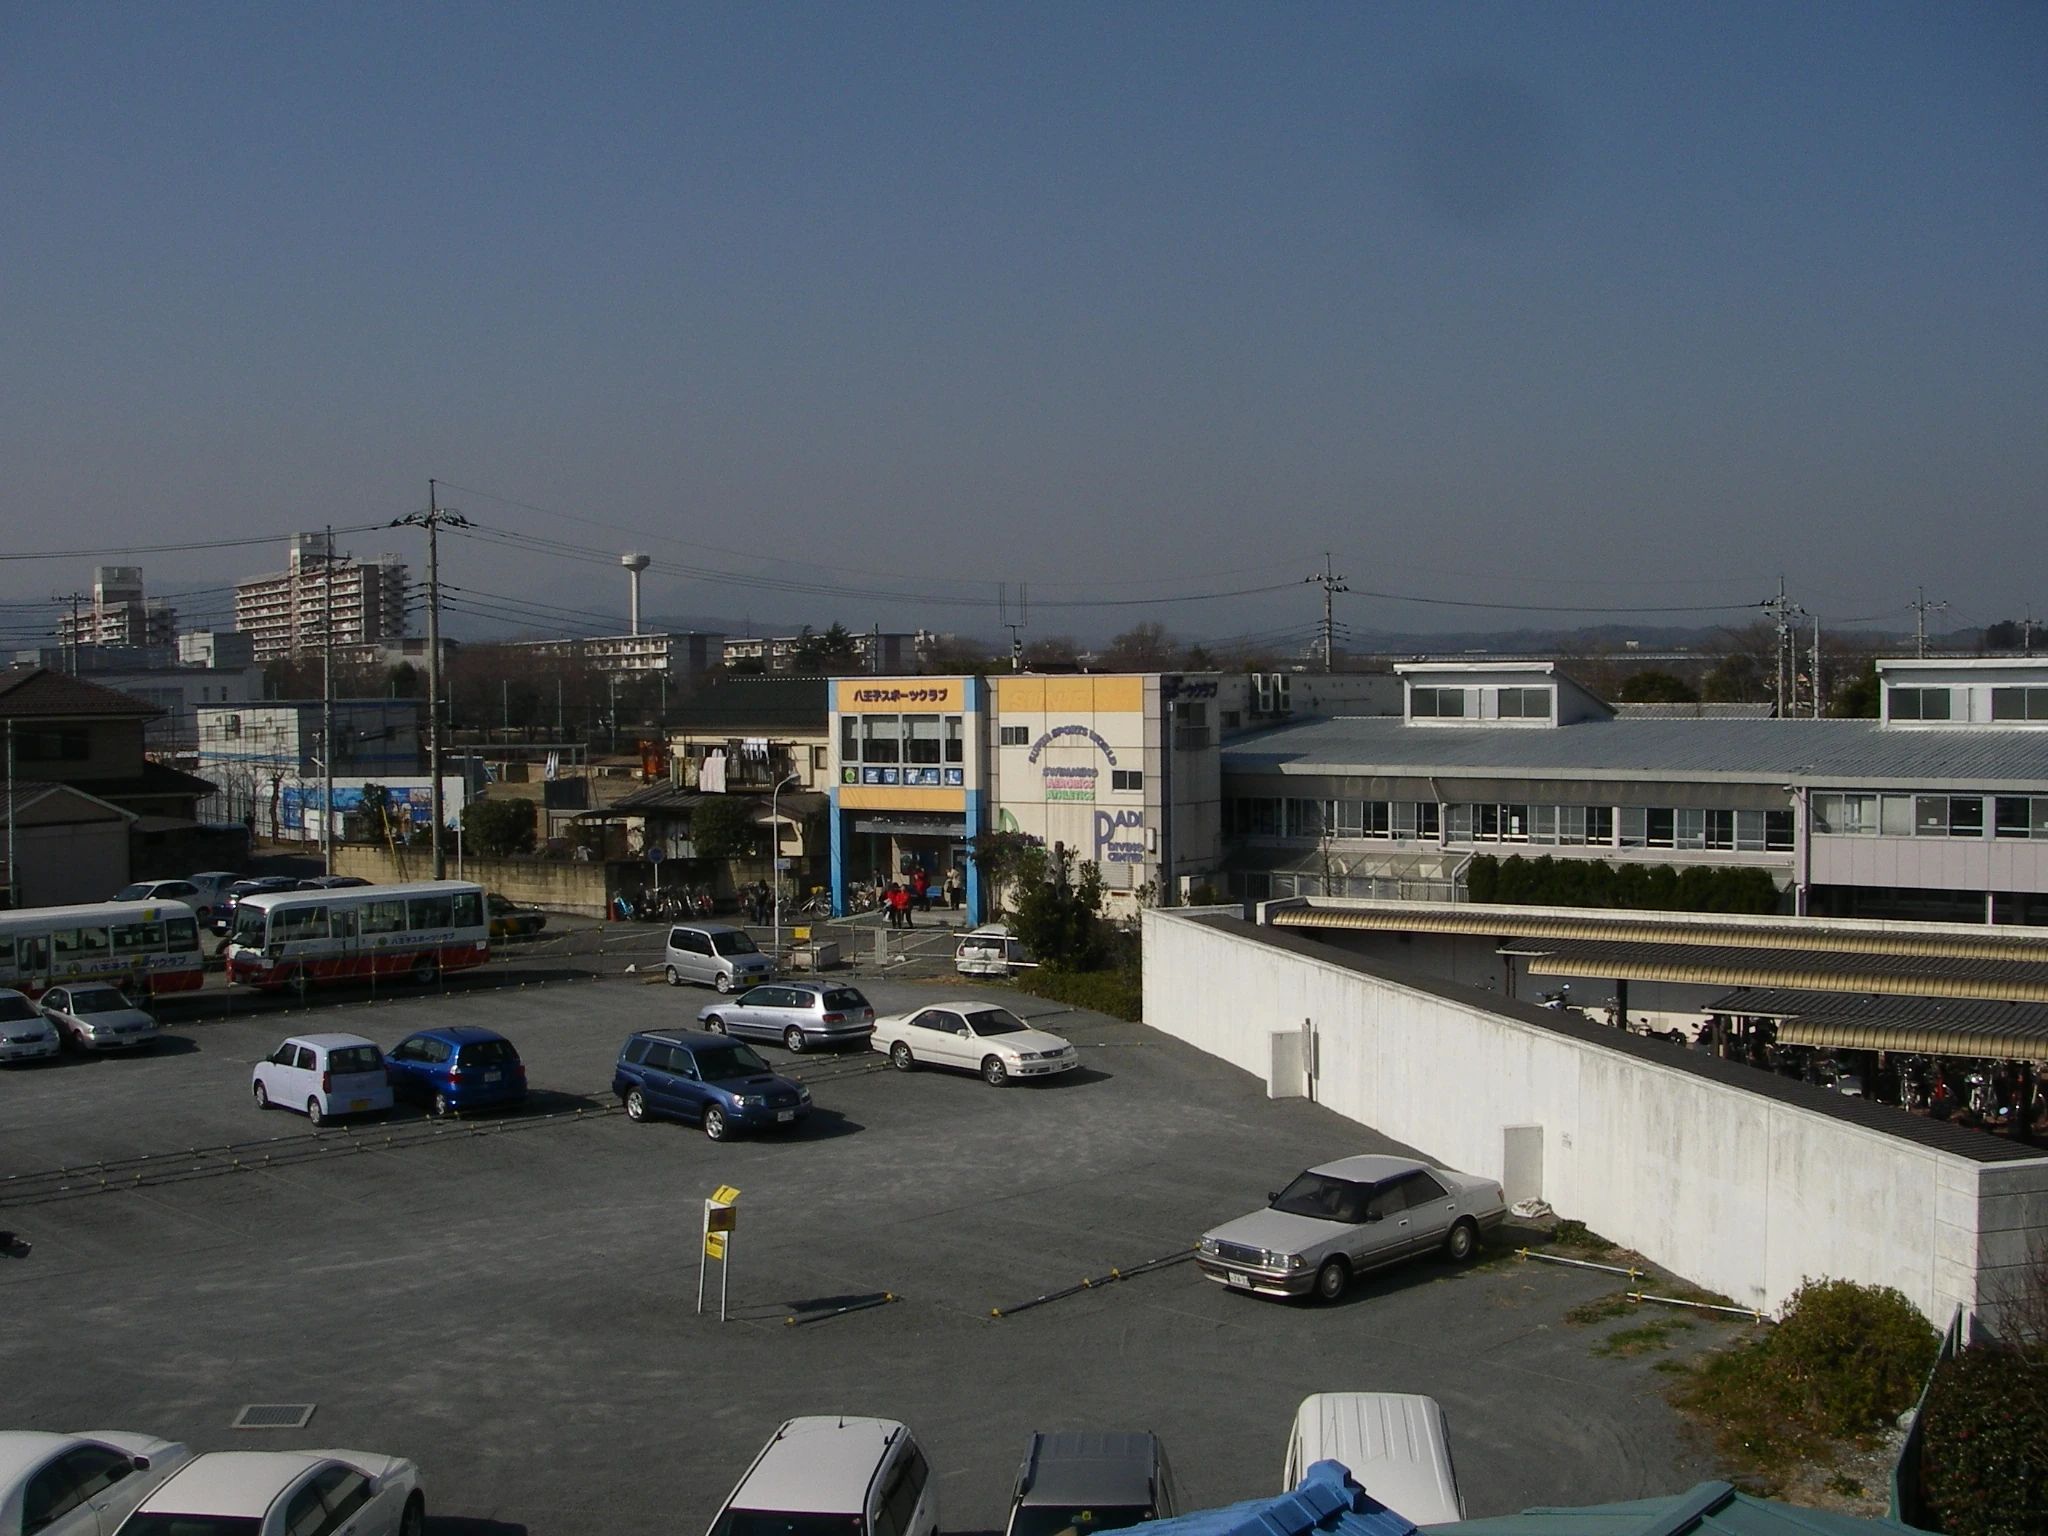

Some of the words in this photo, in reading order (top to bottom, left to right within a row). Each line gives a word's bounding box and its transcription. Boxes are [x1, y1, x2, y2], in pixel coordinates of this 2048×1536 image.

[854, 688, 948, 702] 八王子スポーツクラブ
[1029, 733, 1052, 764] SUPER
[1051, 725, 1088, 738] SPORTS
[1089, 730, 1117, 766] WORLD
[1043, 767, 1098, 777] SWIMMING
[1046, 779, 1095, 789] AEROBICS
[1047, 789, 1095, 800] ATHLETICS
[1094, 810, 1144, 861] PADI
[1108, 842, 1145, 852] DIVING
[1108, 852, 1144, 863] CENTER
[90, 955, 186, 973] 八王子スツクラブ
